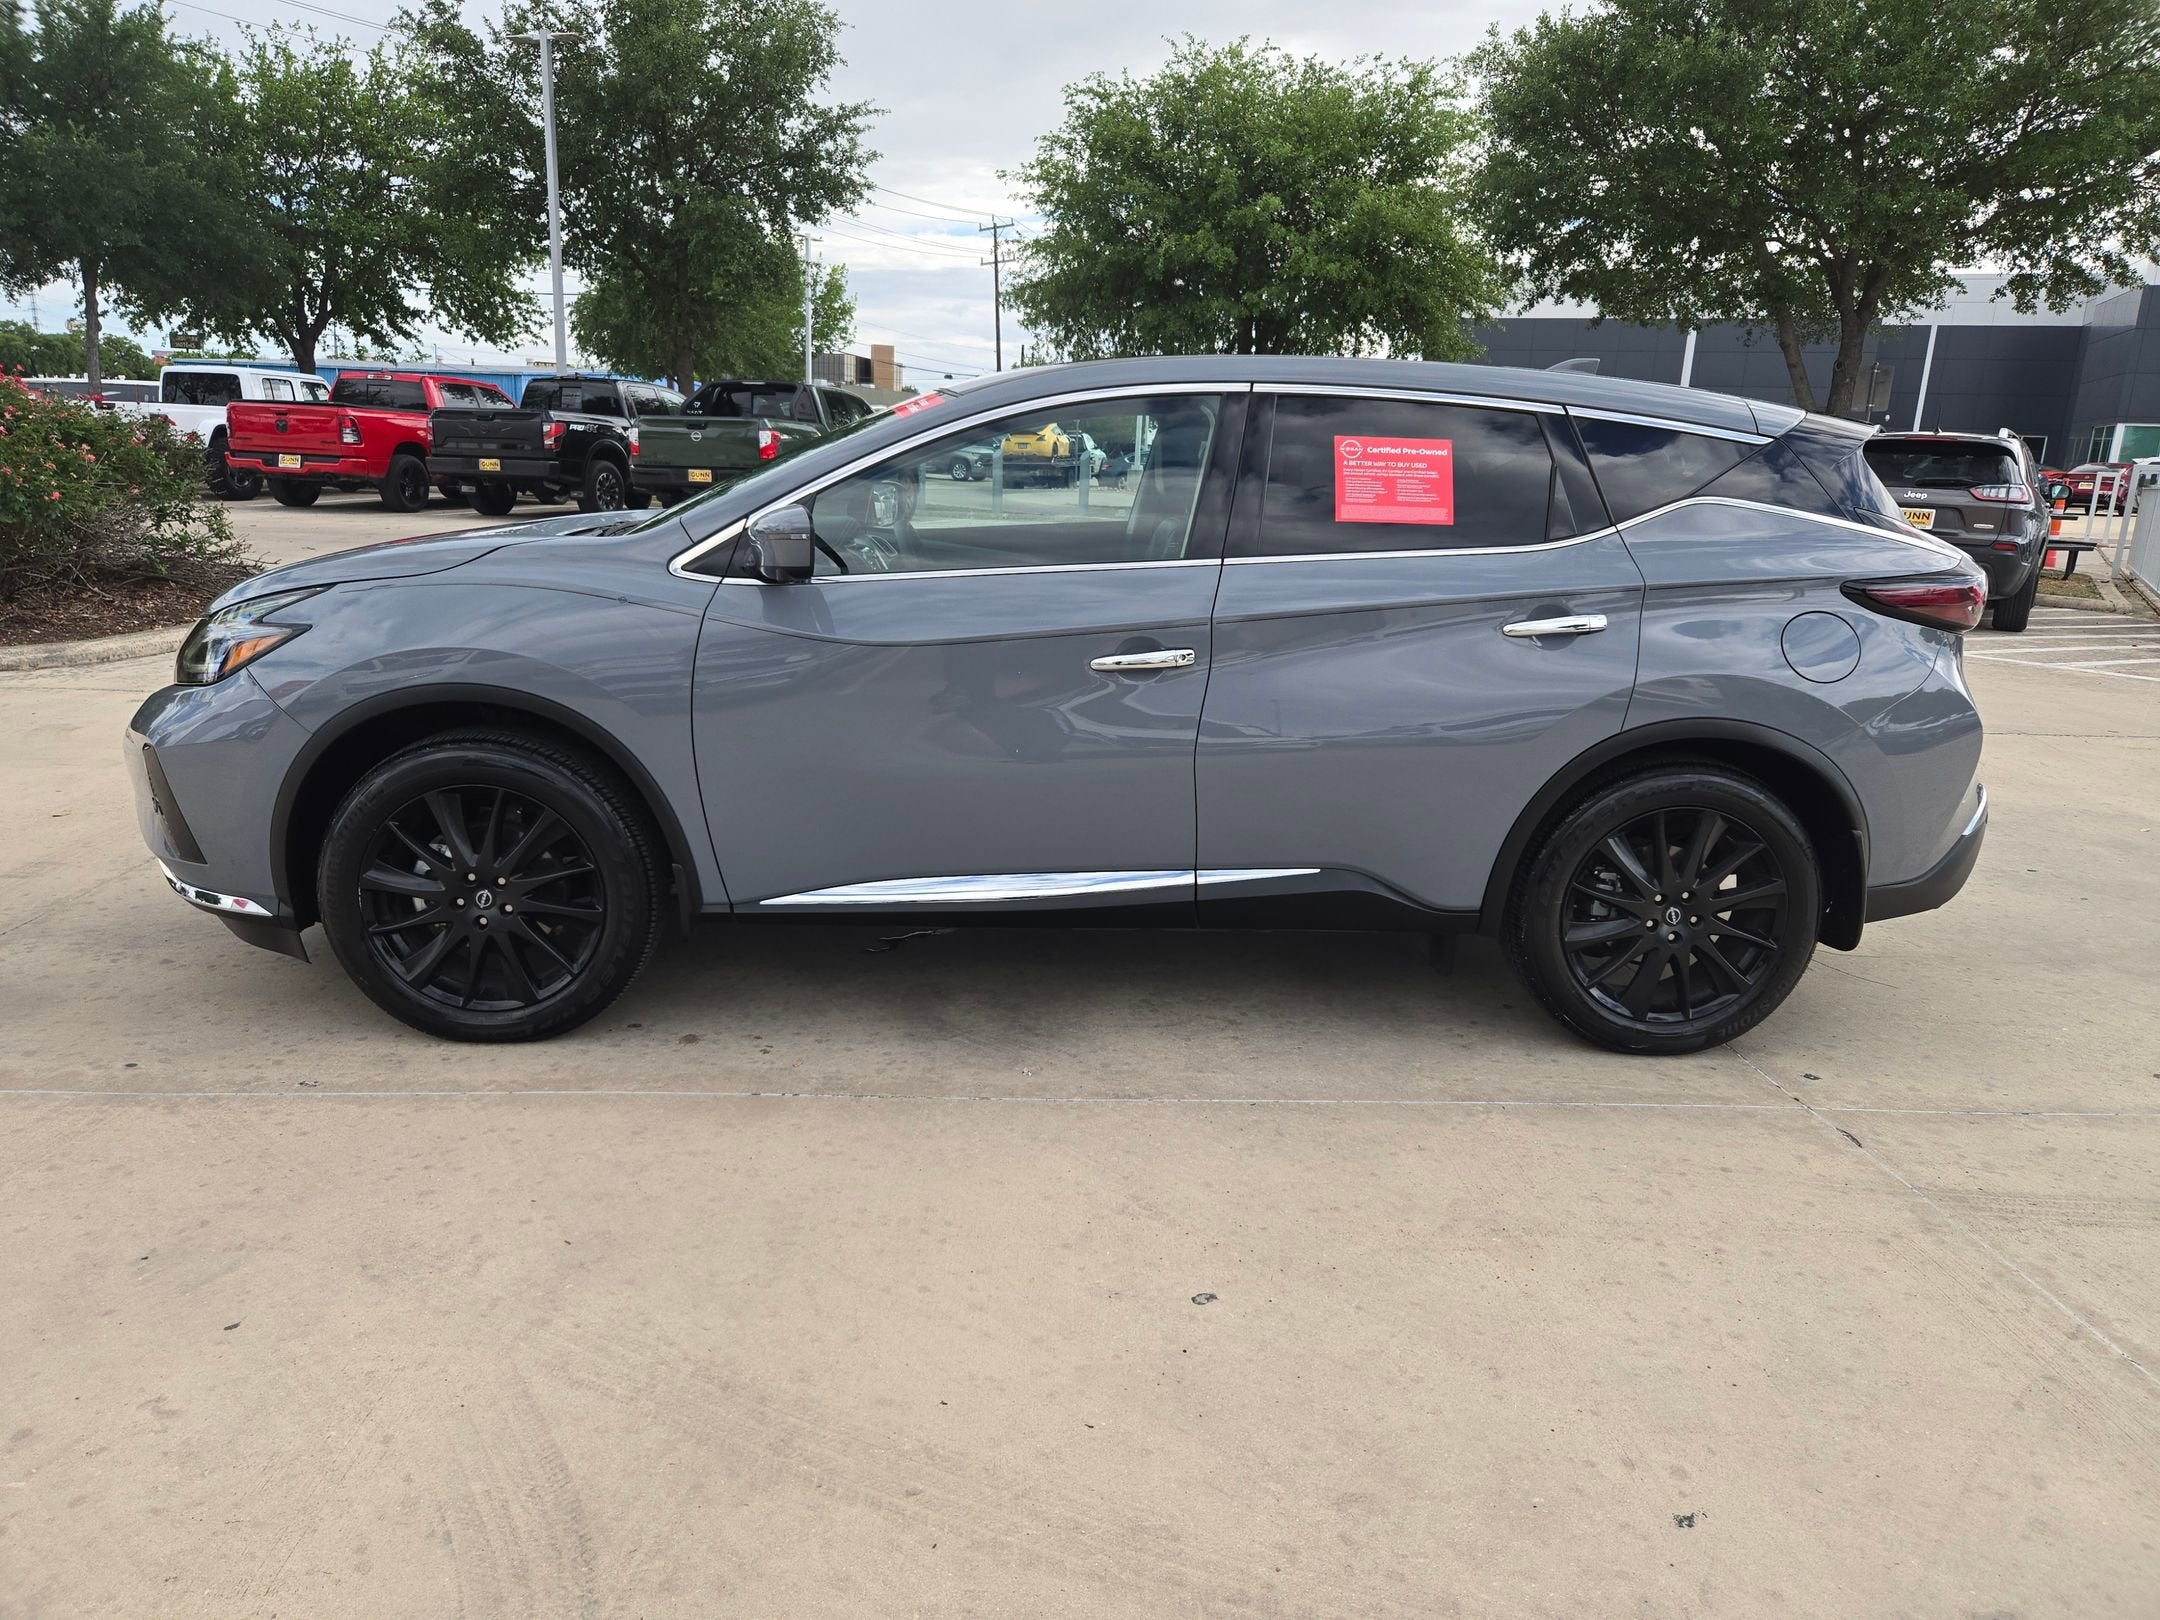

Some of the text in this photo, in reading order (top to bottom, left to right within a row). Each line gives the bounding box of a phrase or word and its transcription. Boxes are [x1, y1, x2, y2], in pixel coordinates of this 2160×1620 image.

[1367, 446, 1448, 456] Certified Pre-Owned
[1903, 490, 1928, 500] Jeep
[1903, 511, 1931, 521] UNN
